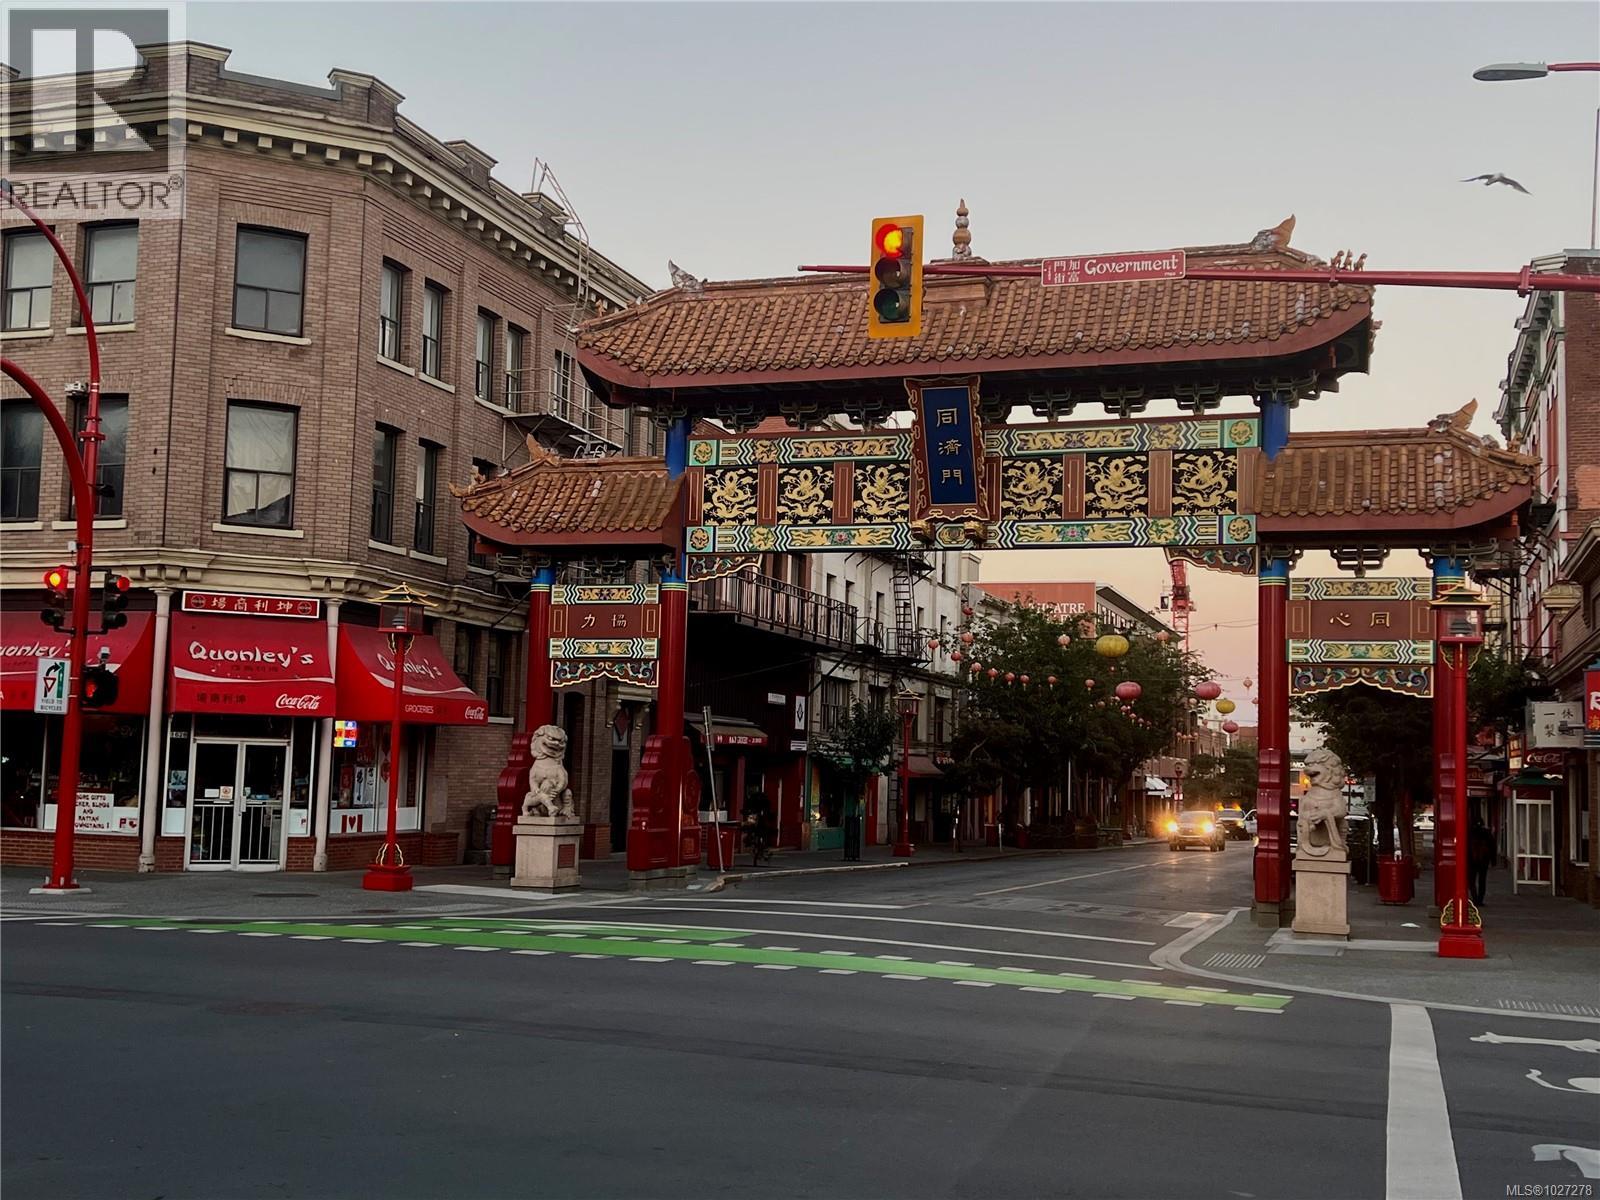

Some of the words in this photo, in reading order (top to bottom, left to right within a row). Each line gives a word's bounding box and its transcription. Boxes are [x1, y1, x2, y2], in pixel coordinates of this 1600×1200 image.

[1084, 254, 1178, 276] Government
[936, 407, 962, 485] 同濟門
[275, 693, 322, 710] Coca-Cola
[404, 704, 434, 714] GROCERIES
